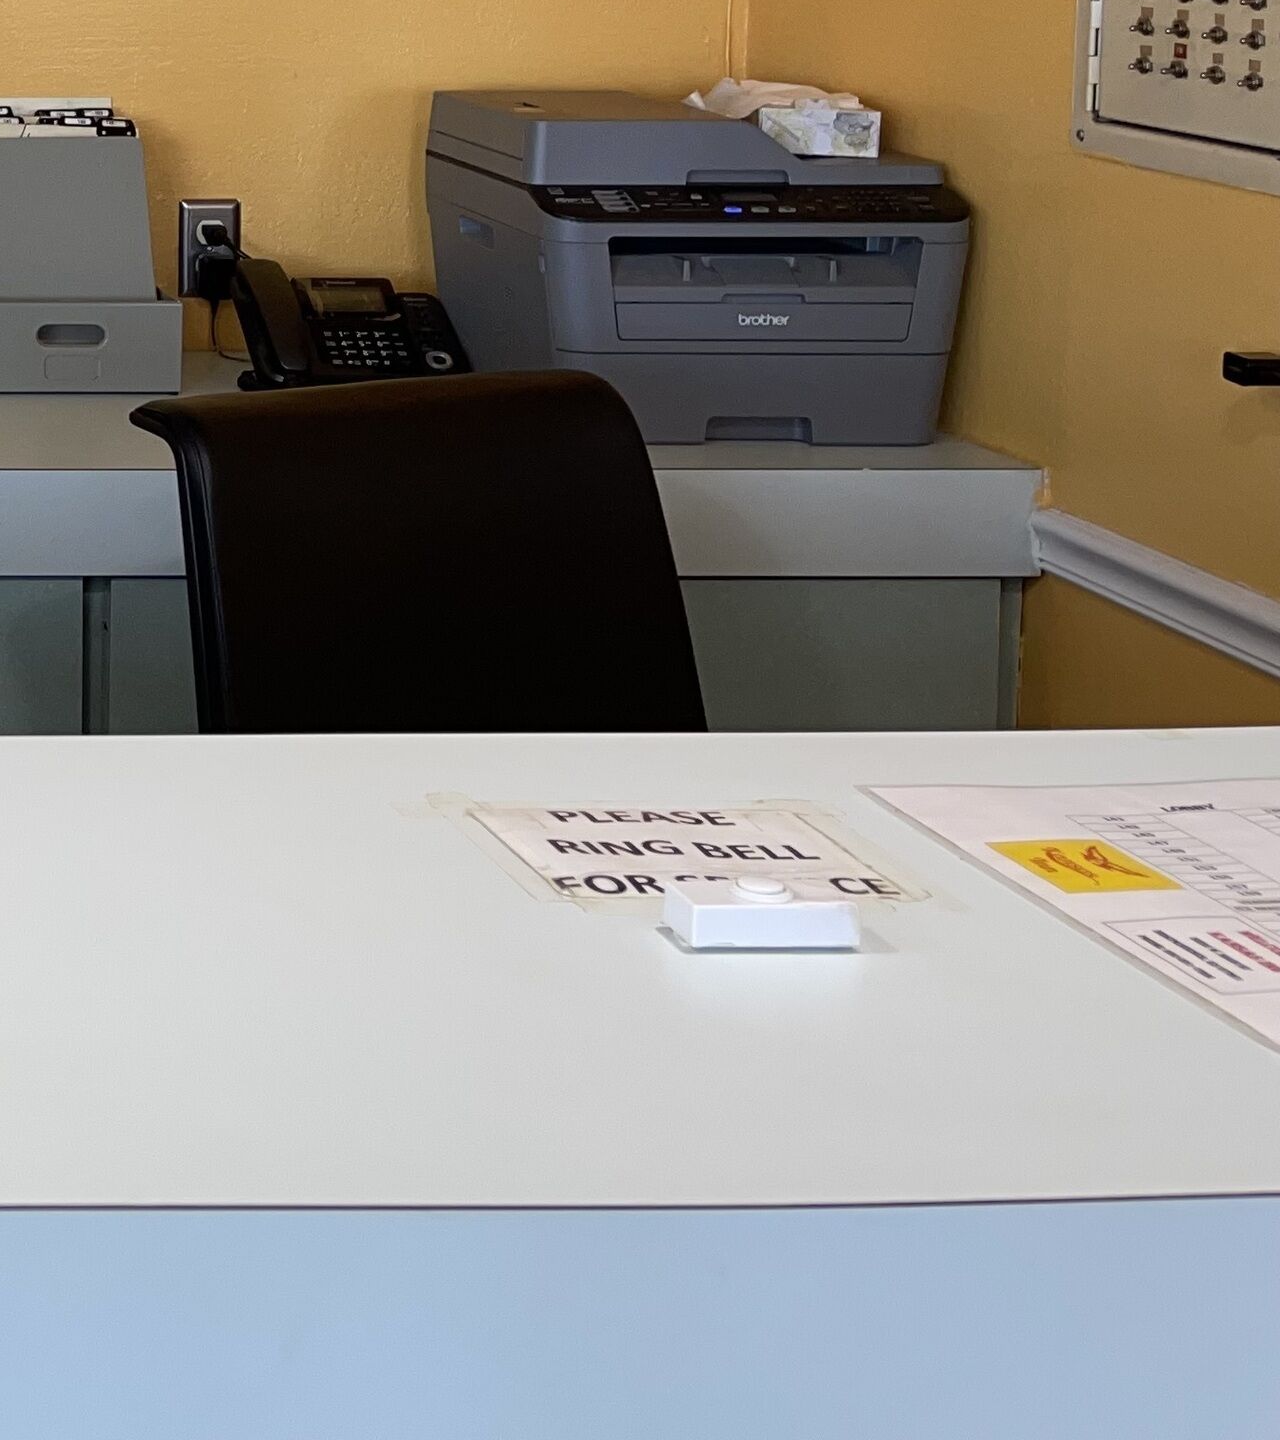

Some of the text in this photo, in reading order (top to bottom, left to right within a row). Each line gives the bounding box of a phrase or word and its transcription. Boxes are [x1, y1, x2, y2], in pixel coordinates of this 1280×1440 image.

[738, 313, 790, 326] brother
[546, 810, 737, 827] PLEASE
[546, 838, 822, 862] RING BELL
[552, 874, 666, 896] FOR
